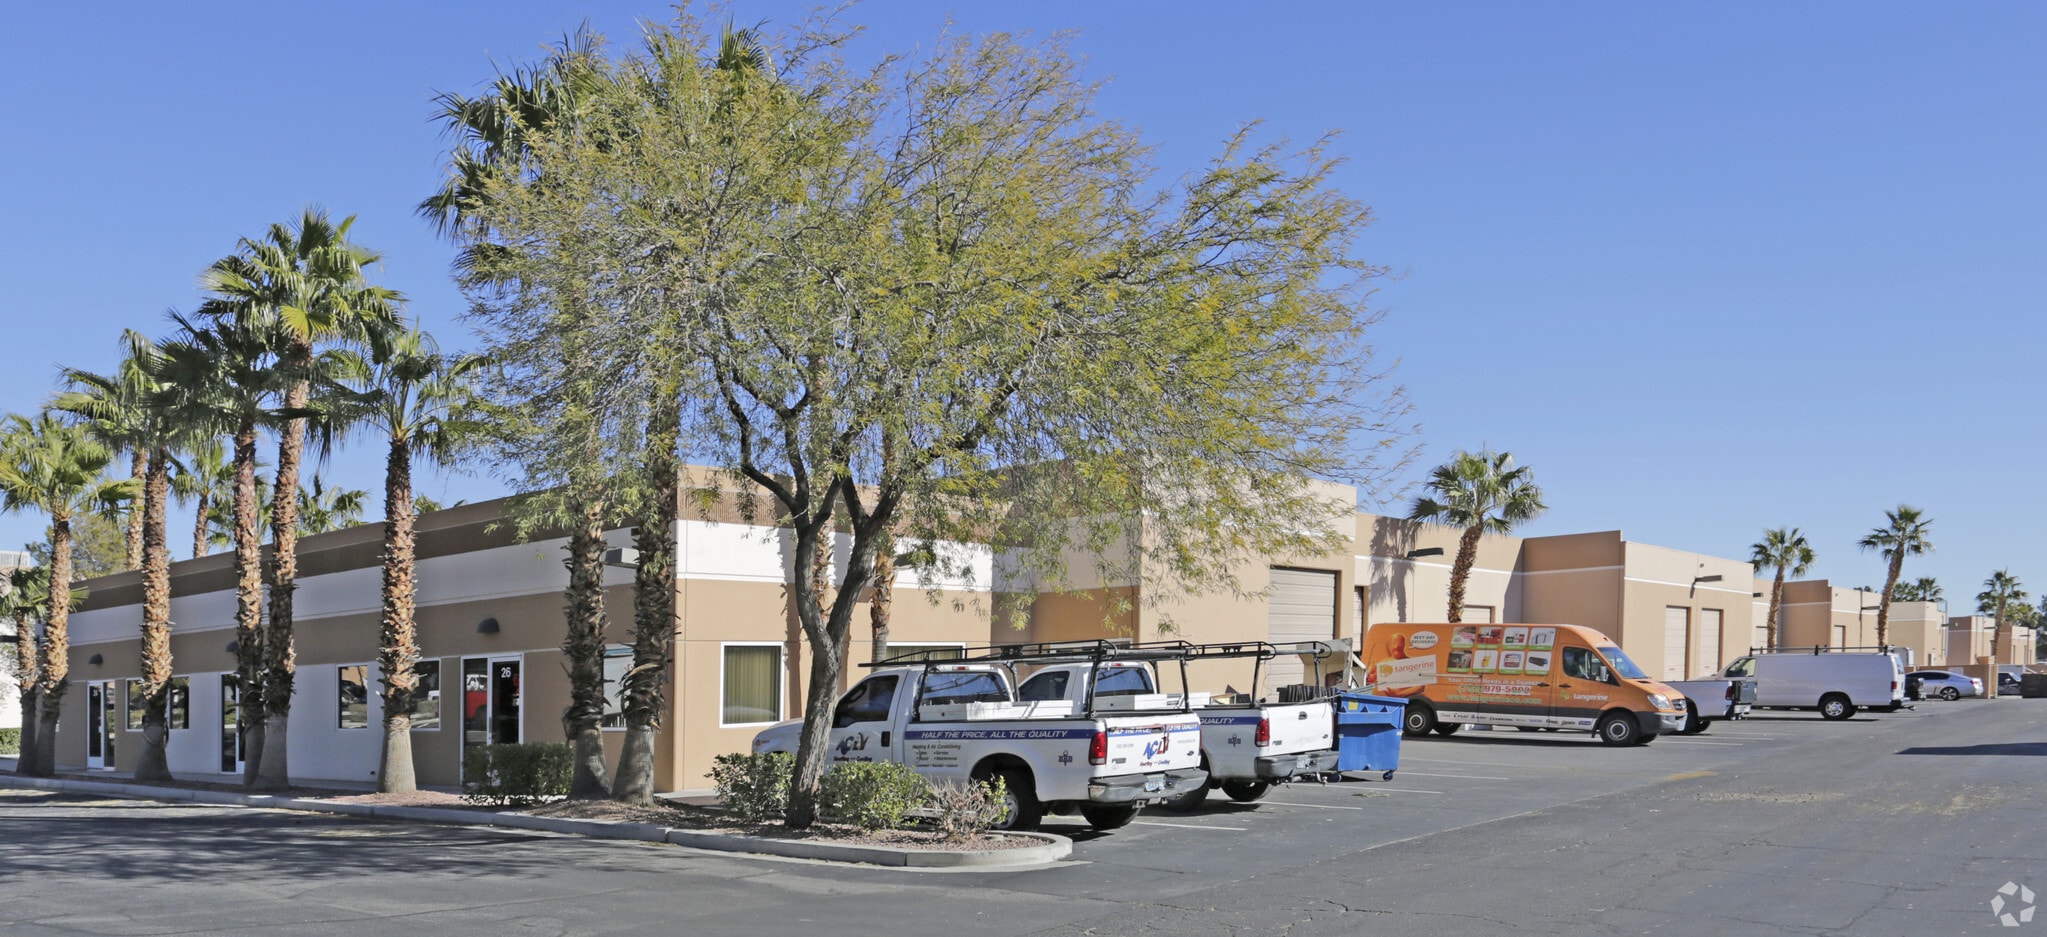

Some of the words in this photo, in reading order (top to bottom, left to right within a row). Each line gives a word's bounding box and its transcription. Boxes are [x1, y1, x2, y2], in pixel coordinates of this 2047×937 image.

[1395, 661, 1434, 672] tangerine
[500, 667, 511, 678] 26
[1574, 693, 1608, 702] tangerine
[1200, 717, 1234, 725] QUALITY
[921, 731, 943, 739] HALF
[962, 731, 988, 739] PRICE,
[1028, 730, 1069, 738] QUALITY
